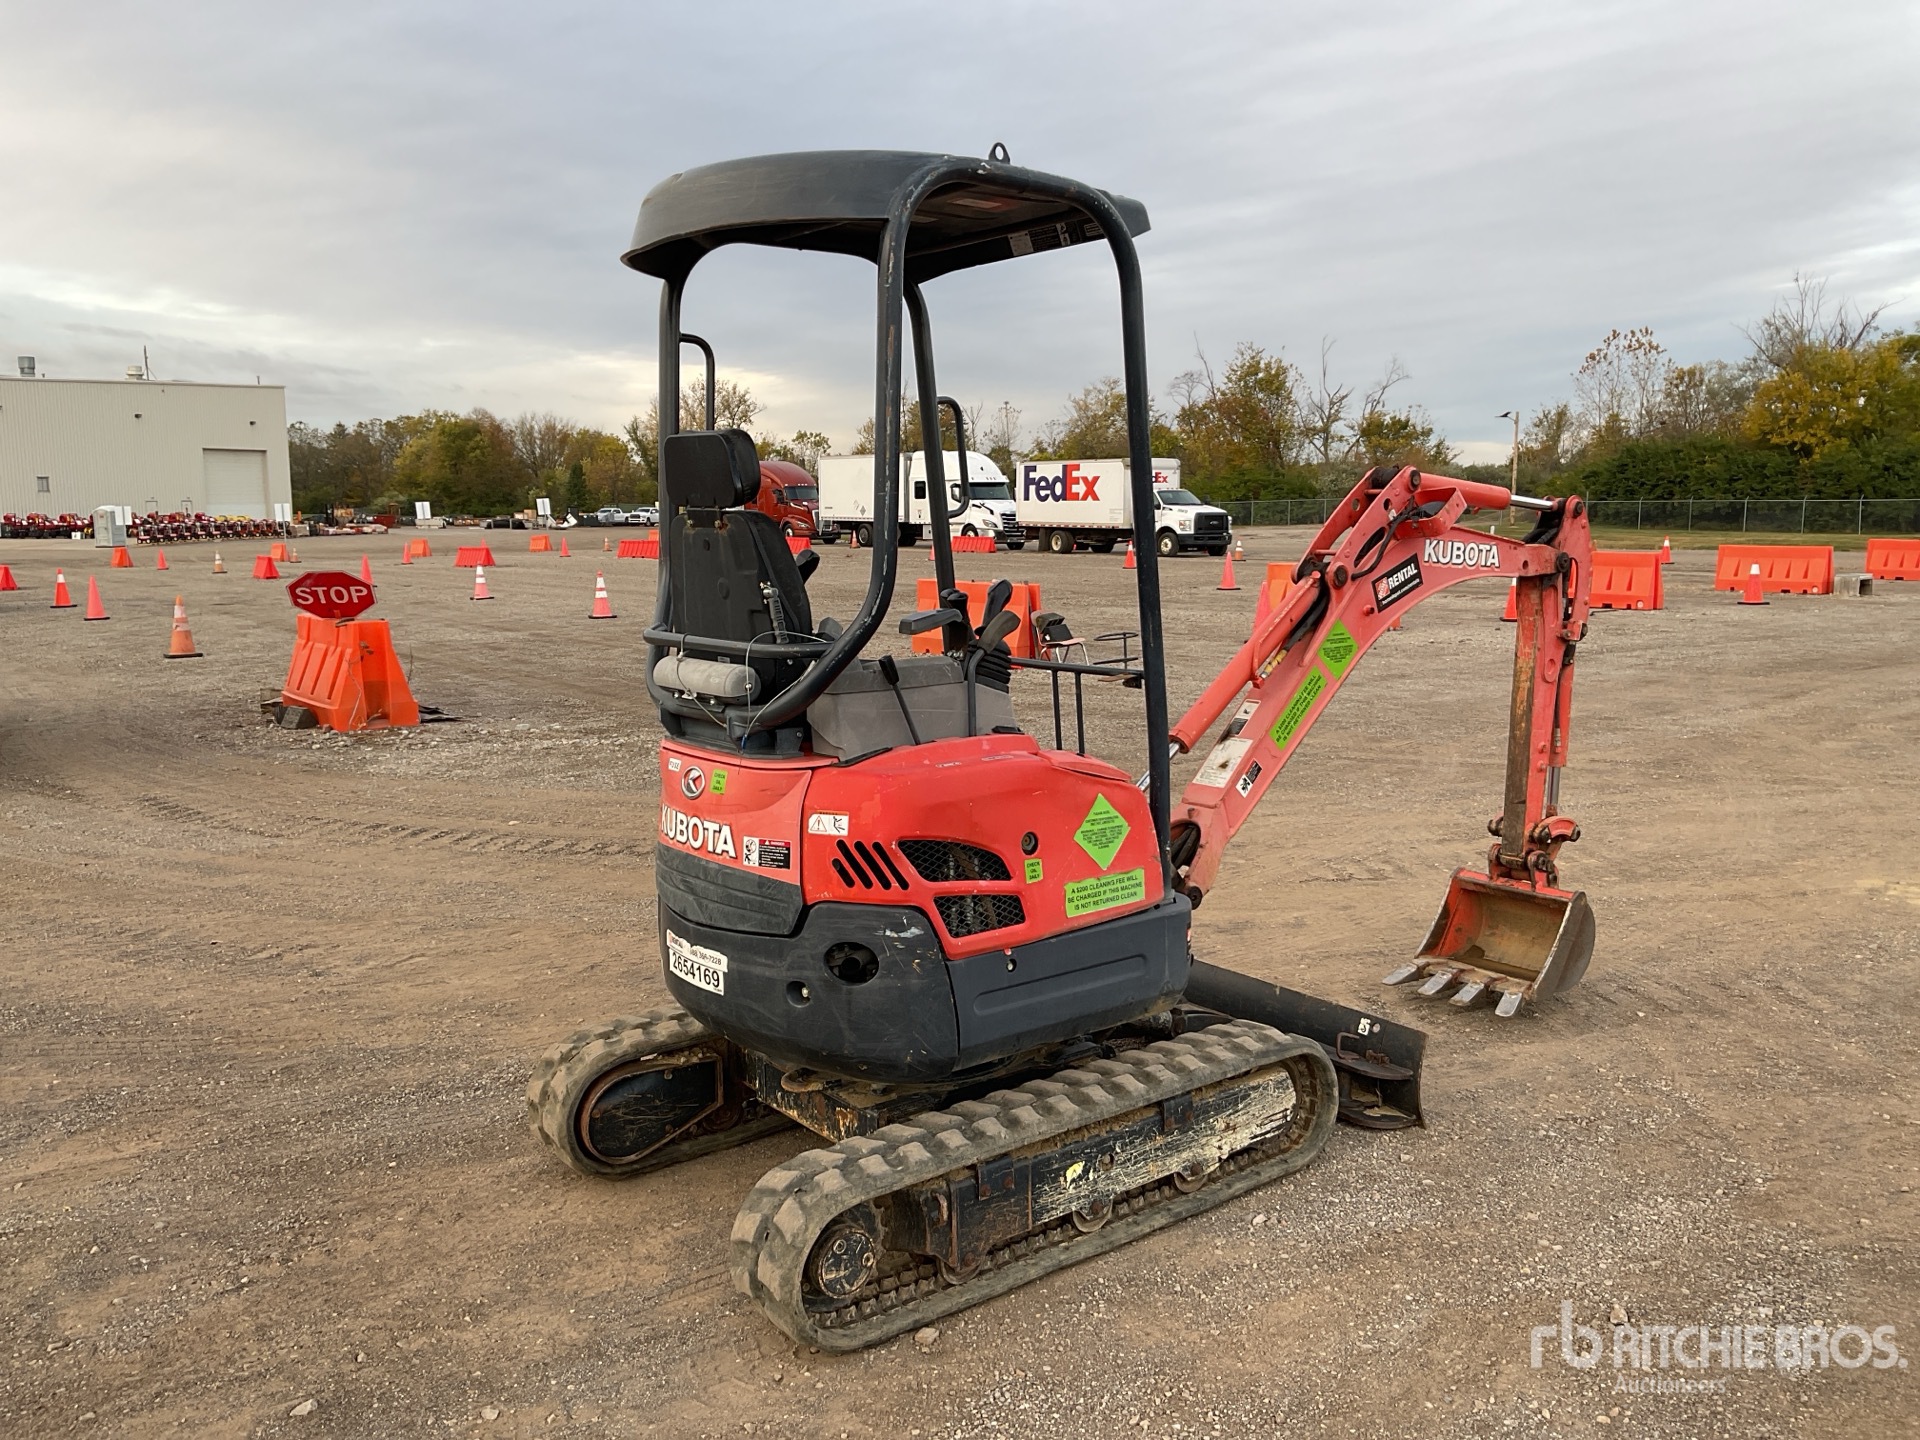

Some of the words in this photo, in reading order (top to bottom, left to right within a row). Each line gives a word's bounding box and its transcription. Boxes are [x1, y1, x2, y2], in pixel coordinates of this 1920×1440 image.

[1023, 463, 1100, 502] FedEx
[1424, 539, 1500, 568] KUBOTA
[1388, 563, 1418, 590] RENTAL
[295, 586, 368, 605] STOP
[1285, 694, 1303, 719] CLEANING
[1307, 675, 1316, 686] WILL
[1286, 725, 1294, 736] NOT
[1293, 700, 1311, 726] RETURNED
[1310, 684, 1322, 700] CLEAN
[661, 803, 738, 859] KUBOTA
[1075, 891, 1102, 902] CHARGED
[1108, 886, 1120, 894] THIS
[1120, 881, 1143, 891] MACHINE
[1076, 885, 1089, 894] $200
[1089, 879, 1115, 891] CLEANING
[1116, 876, 1126, 885] FEE
[1126, 874, 1138, 882] WILL
[1080, 900, 1091, 910] NOT
[1092, 894, 1120, 907] RETURNED
[1120, 891, 1138, 900] CLEAN
[672, 951, 720, 988] 2654169
